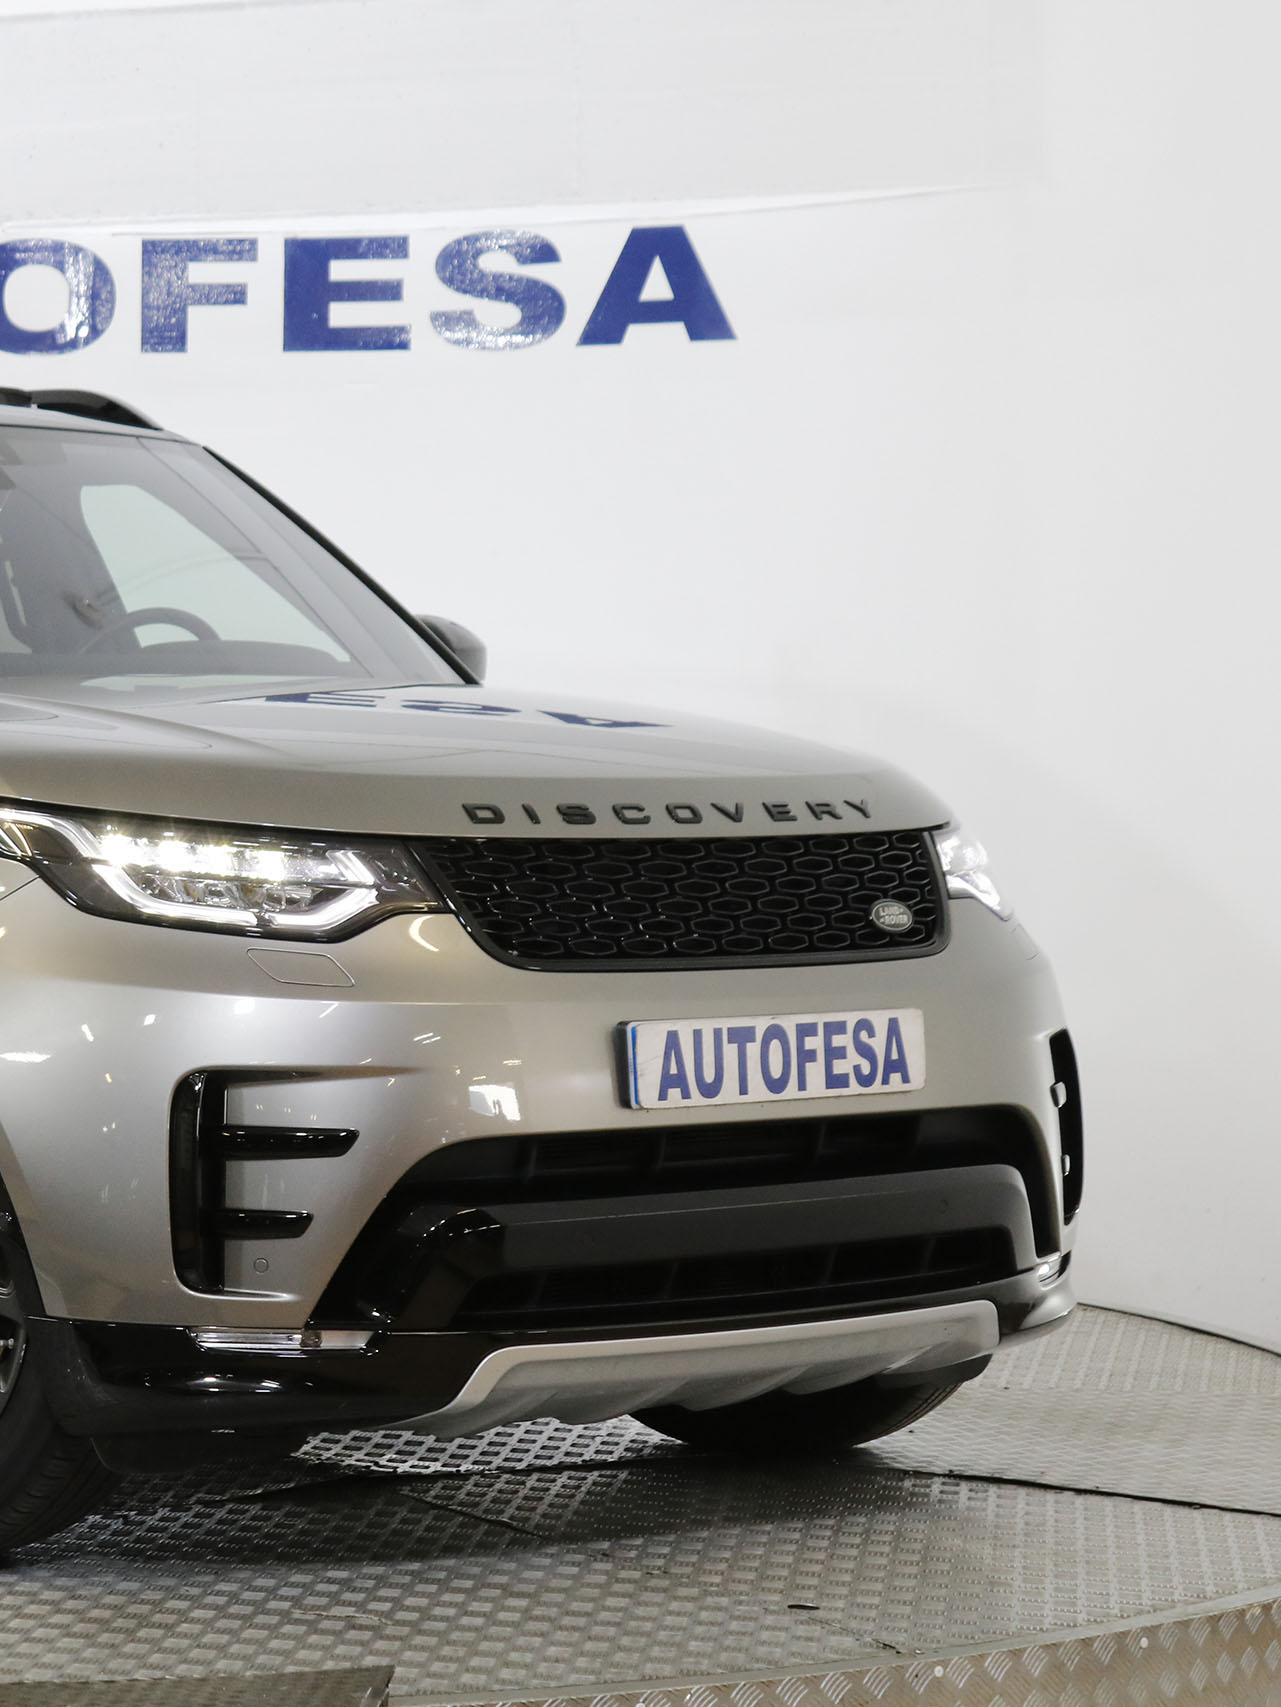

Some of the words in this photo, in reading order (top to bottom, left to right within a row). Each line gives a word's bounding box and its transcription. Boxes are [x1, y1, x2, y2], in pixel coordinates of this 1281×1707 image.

[461, 798, 872, 826] DISCOVERY
[884, 914, 908, 925] ROVER
[657, 1017, 911, 1102] AUTOFESA
